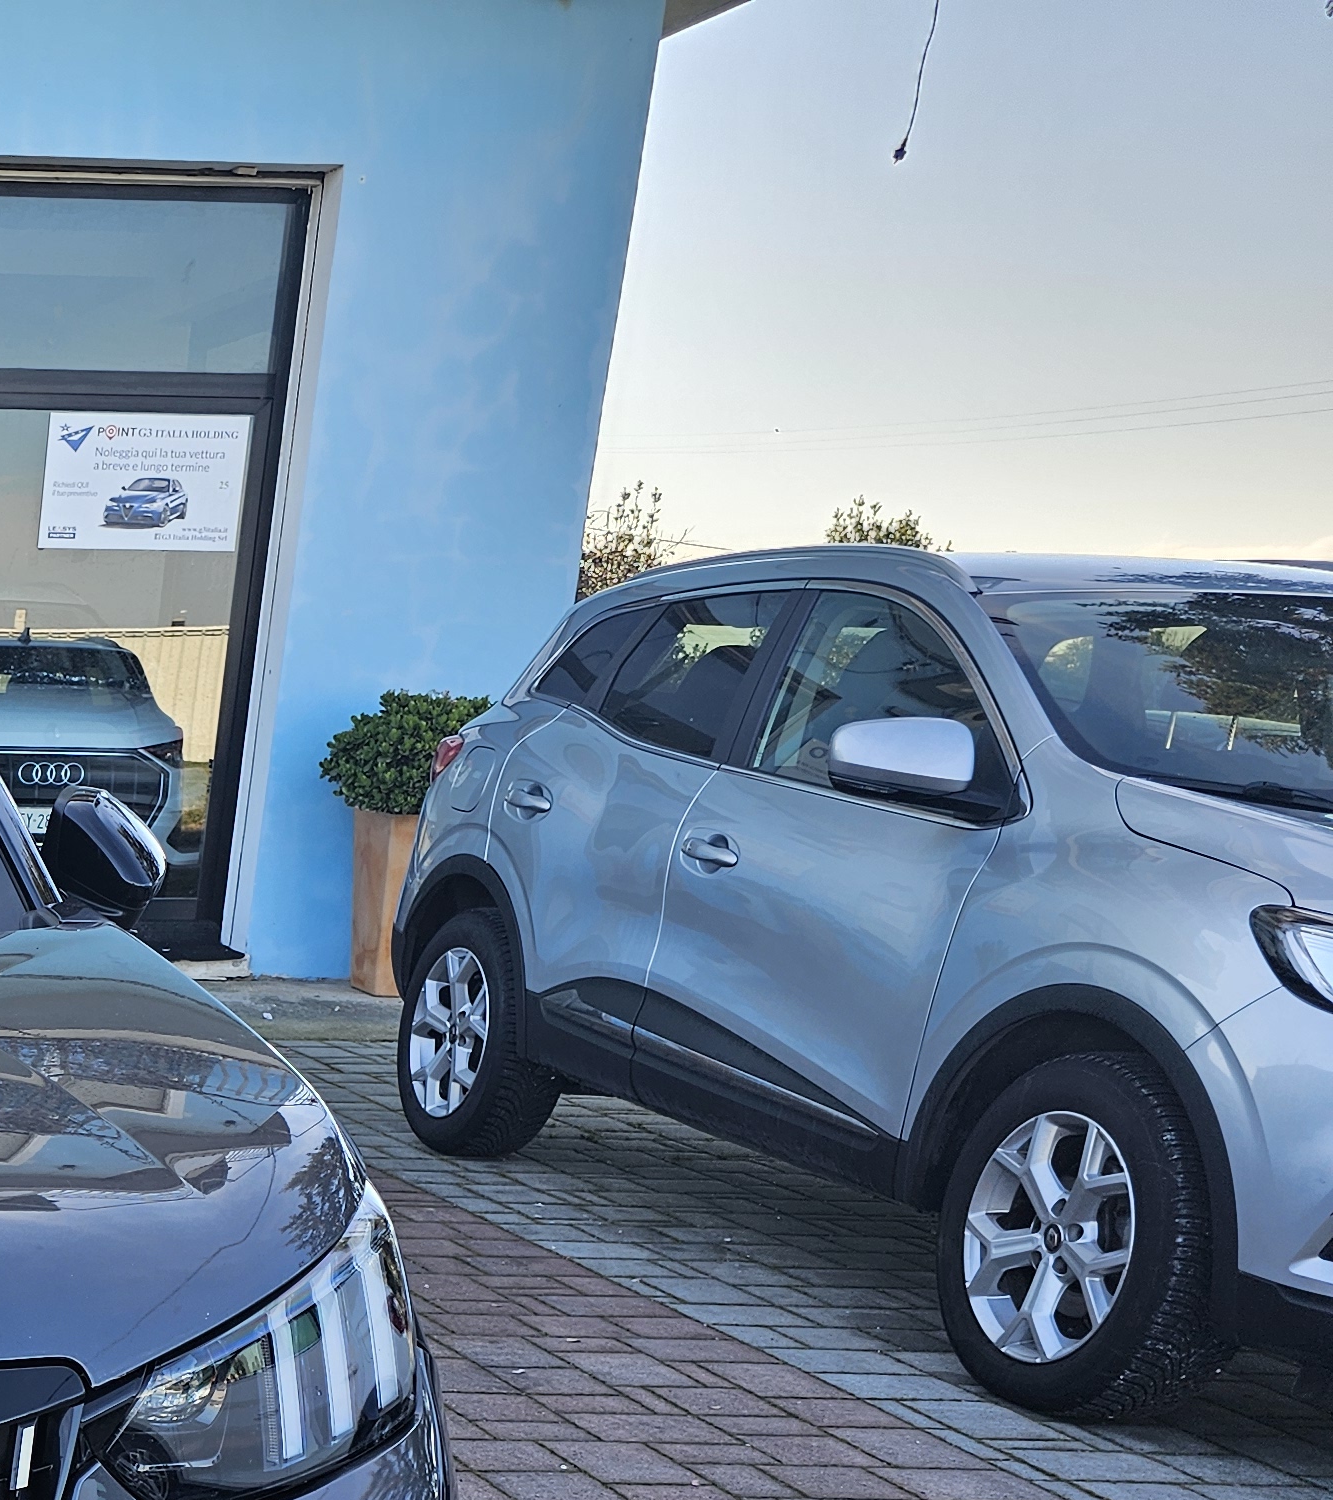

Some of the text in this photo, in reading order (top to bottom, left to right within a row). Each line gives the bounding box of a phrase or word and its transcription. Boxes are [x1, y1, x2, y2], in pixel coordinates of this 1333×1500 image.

[138, 427, 153, 438] G3
[155, 429, 189, 439] ITALIA
[191, 430, 239, 440] HOLDING
[94, 446, 226, 461] Noleggia qui la tua vettura
[93, 460, 210, 474] a breve e lungo termine
